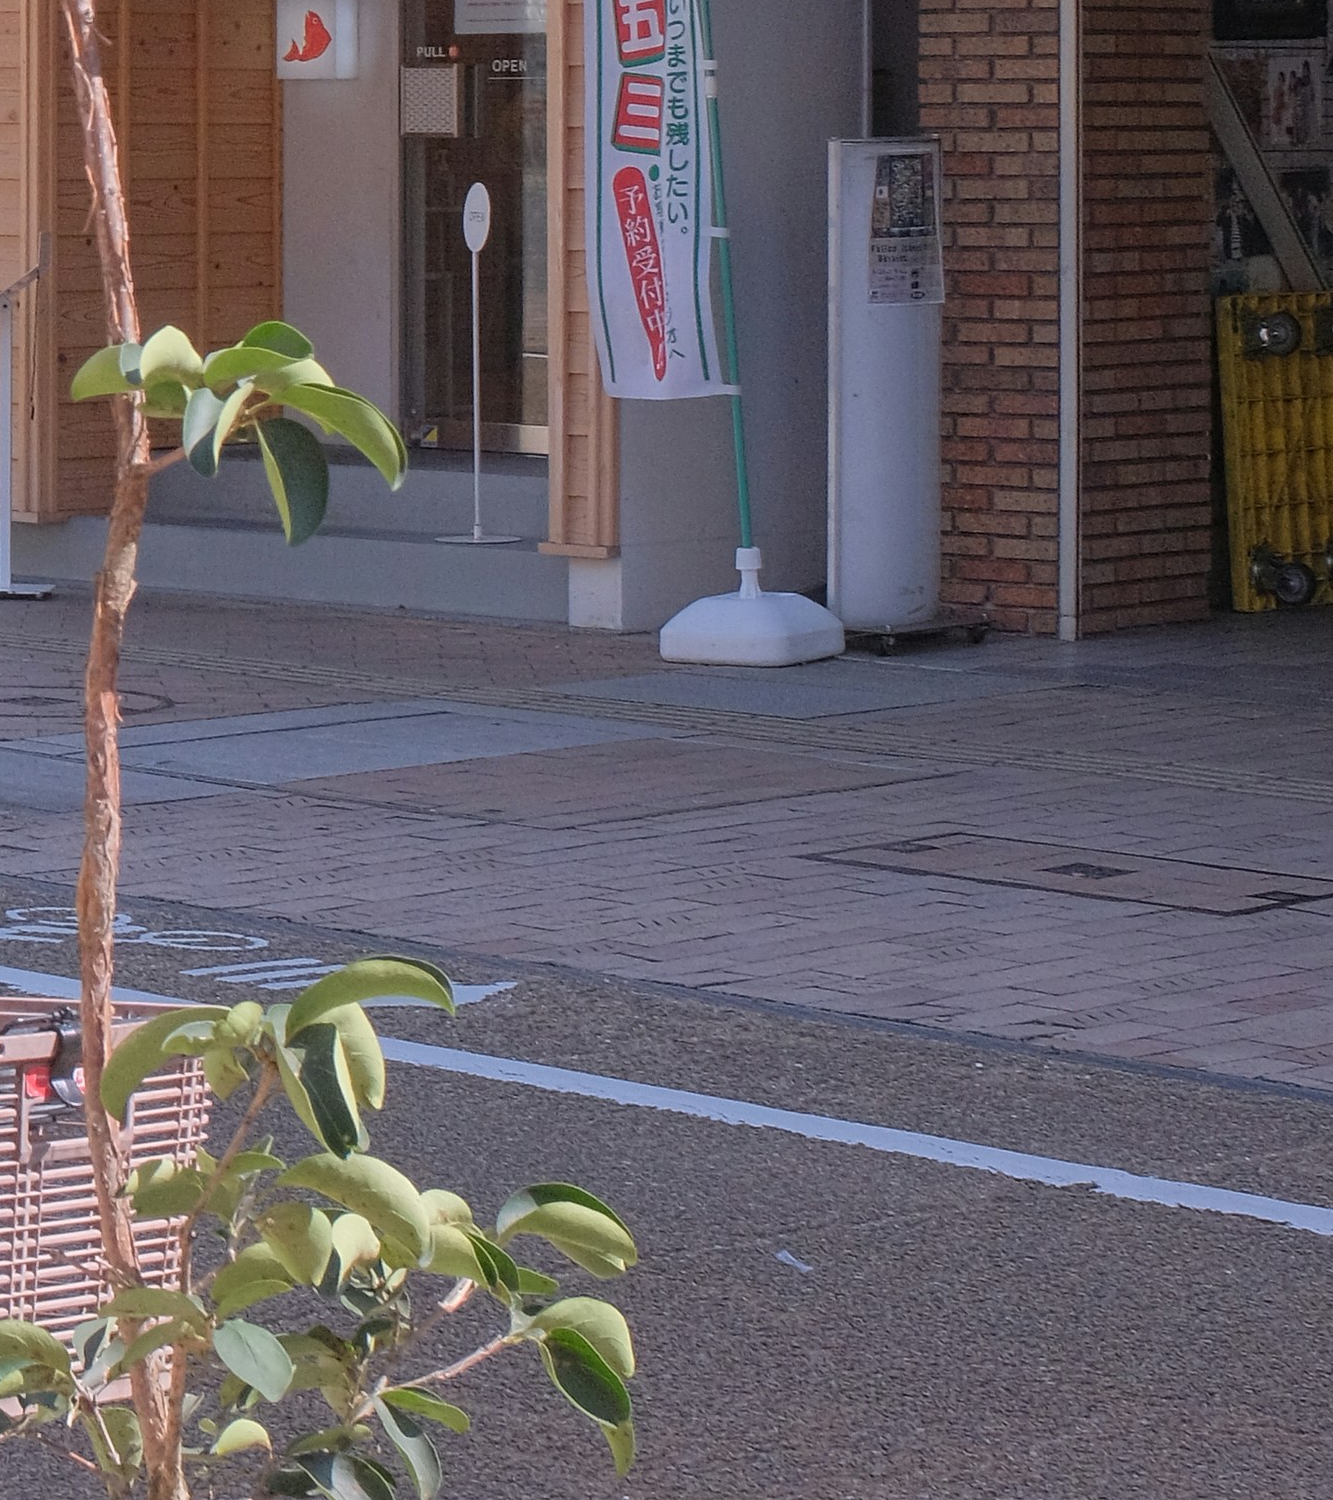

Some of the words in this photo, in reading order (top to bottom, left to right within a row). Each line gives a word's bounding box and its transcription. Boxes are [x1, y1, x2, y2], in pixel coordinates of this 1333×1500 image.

[417, 46, 446, 58] PULL
[492, 59, 527, 72] OPEN
[618, 185, 666, 370] 予約受付中!
